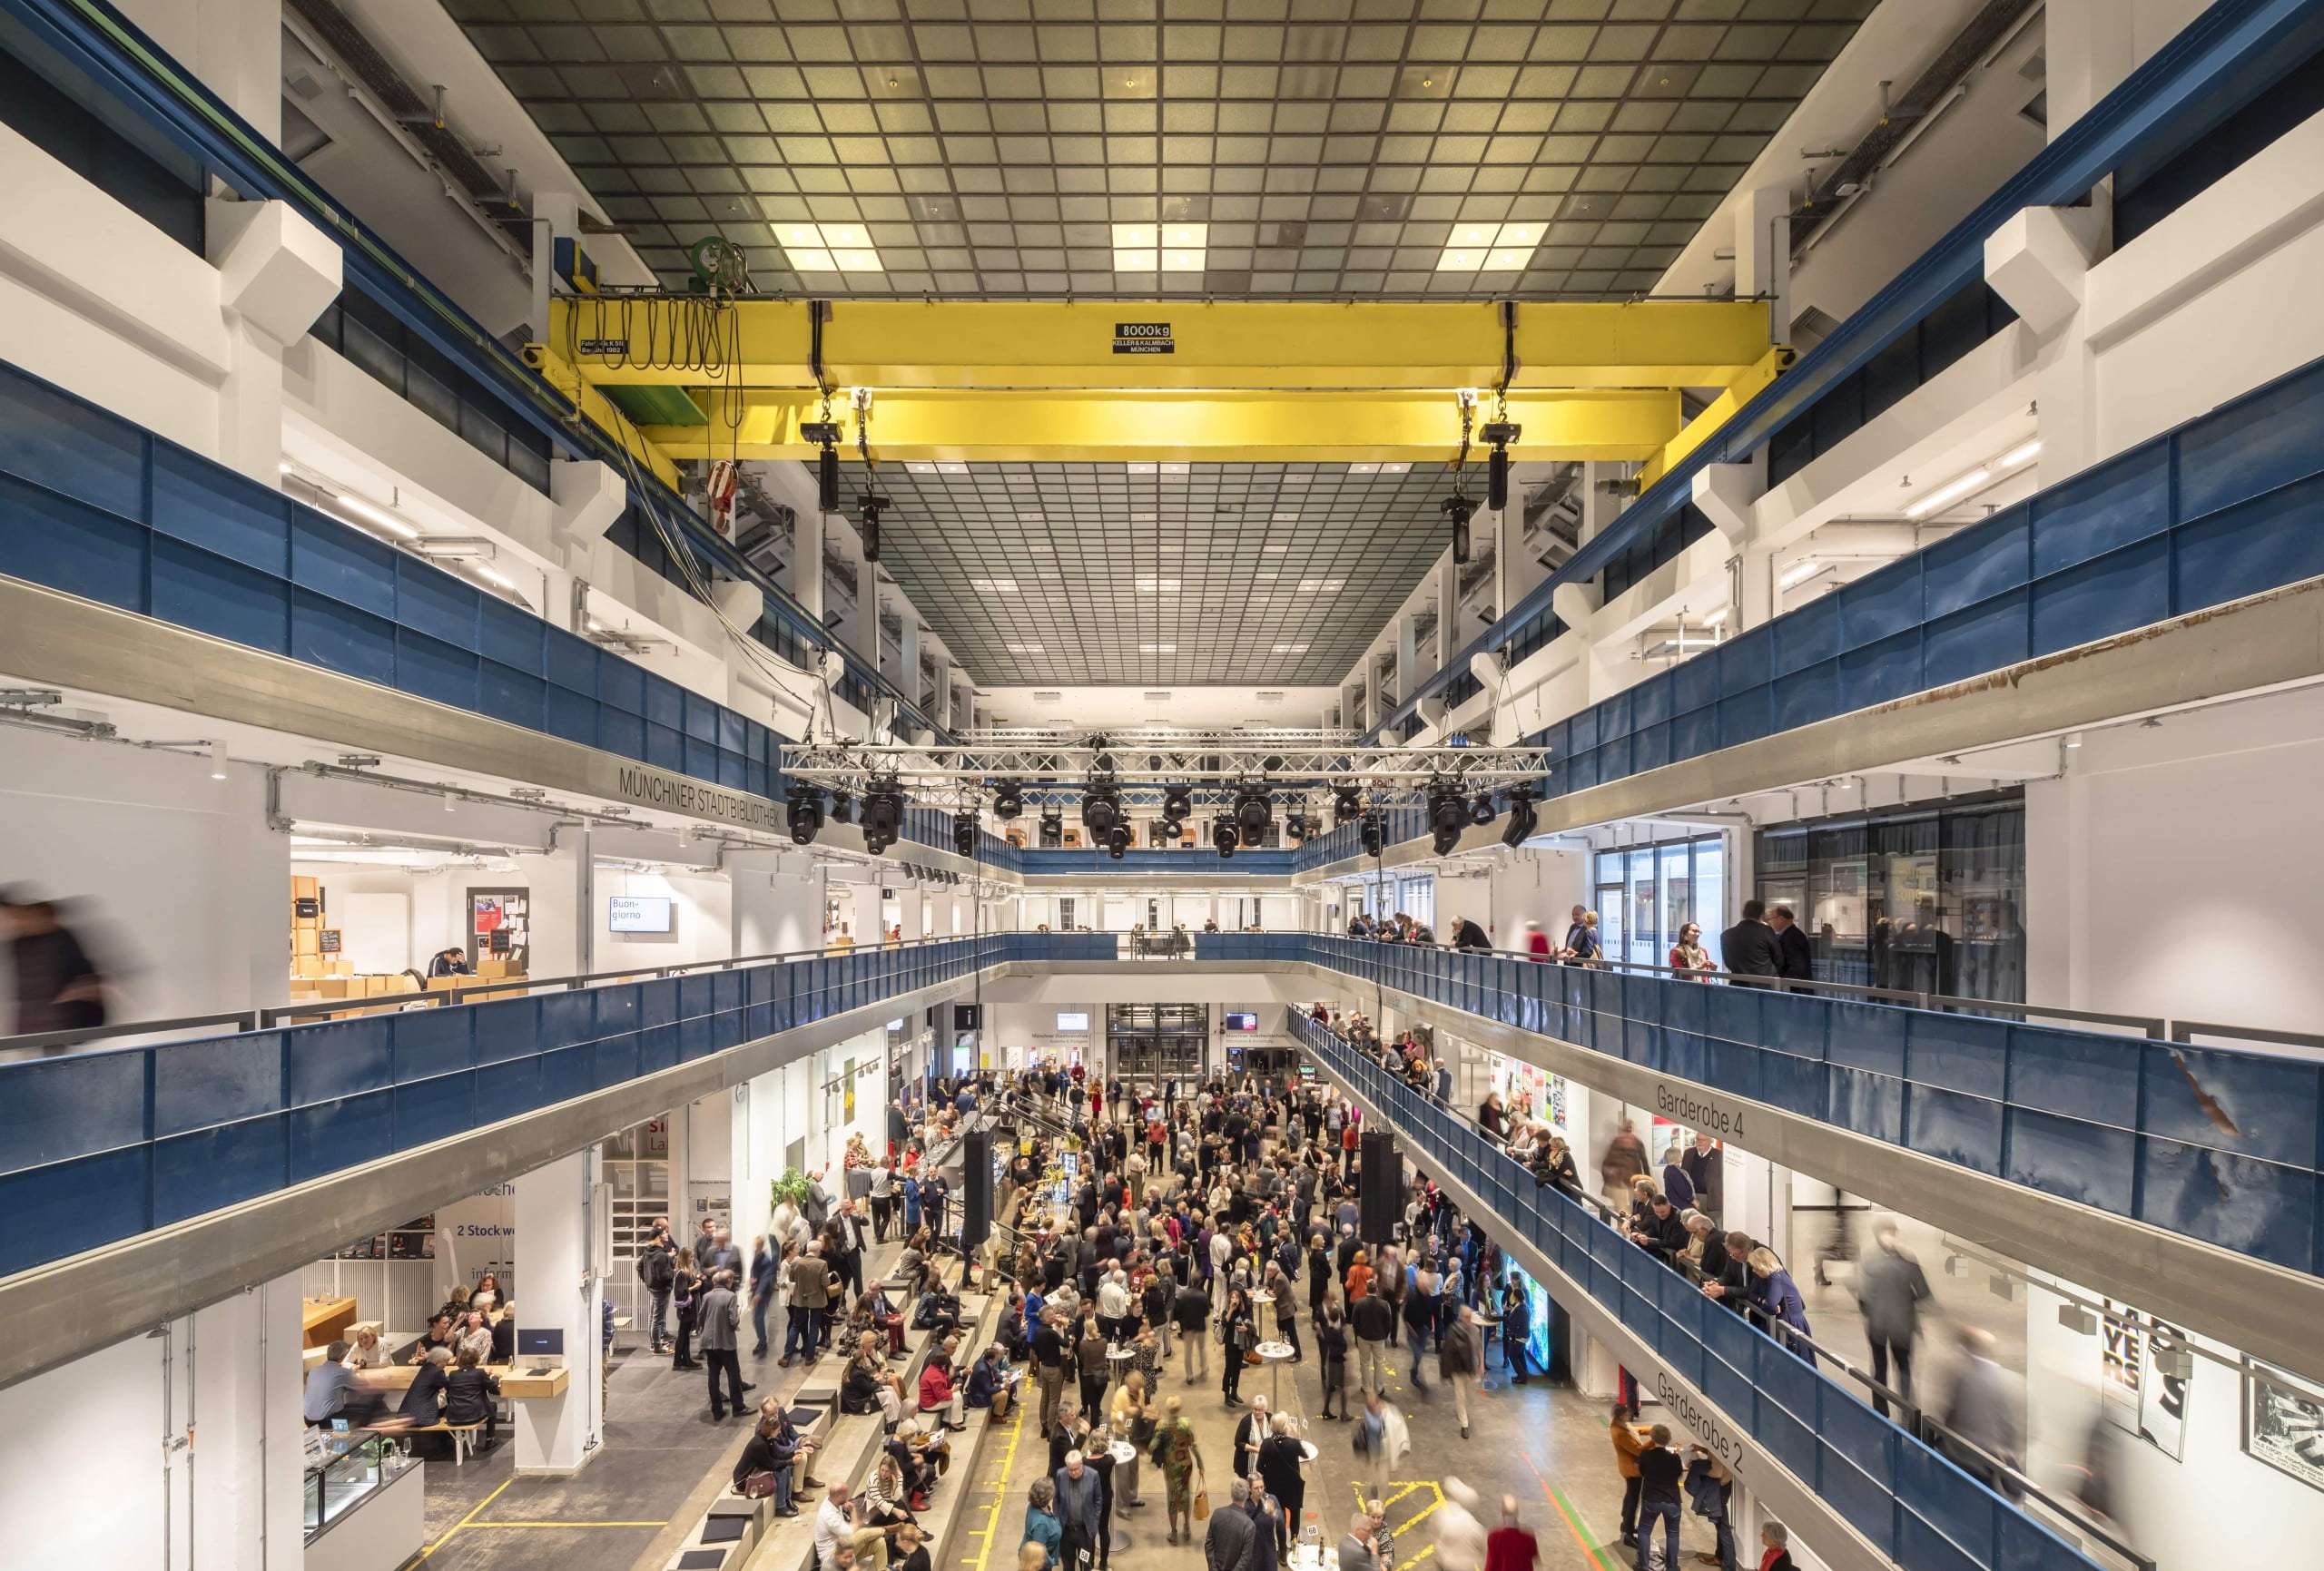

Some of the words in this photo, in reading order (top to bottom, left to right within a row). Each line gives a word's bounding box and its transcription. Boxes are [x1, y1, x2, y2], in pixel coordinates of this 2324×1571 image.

[1124, 325, 1169, 336] 8000kg
[620, 766, 695, 810] MÜNCHNER
[697, 788, 780, 828] STADTBIBLIOTHEK
[613, 898, 639, 908] Buon-
[612, 909, 641, 921] giorno
[1657, 1085, 1729, 1134] Garderobe
[1733, 1111, 1744, 1140] 4
[650, 1137, 669, 1151] La
[458, 1225, 465, 1236] 2
[468, 1224, 500, 1236] Stock
[1658, 1371, 1729, 1459] Garderobe
[1733, 1442, 1743, 1475] 2
